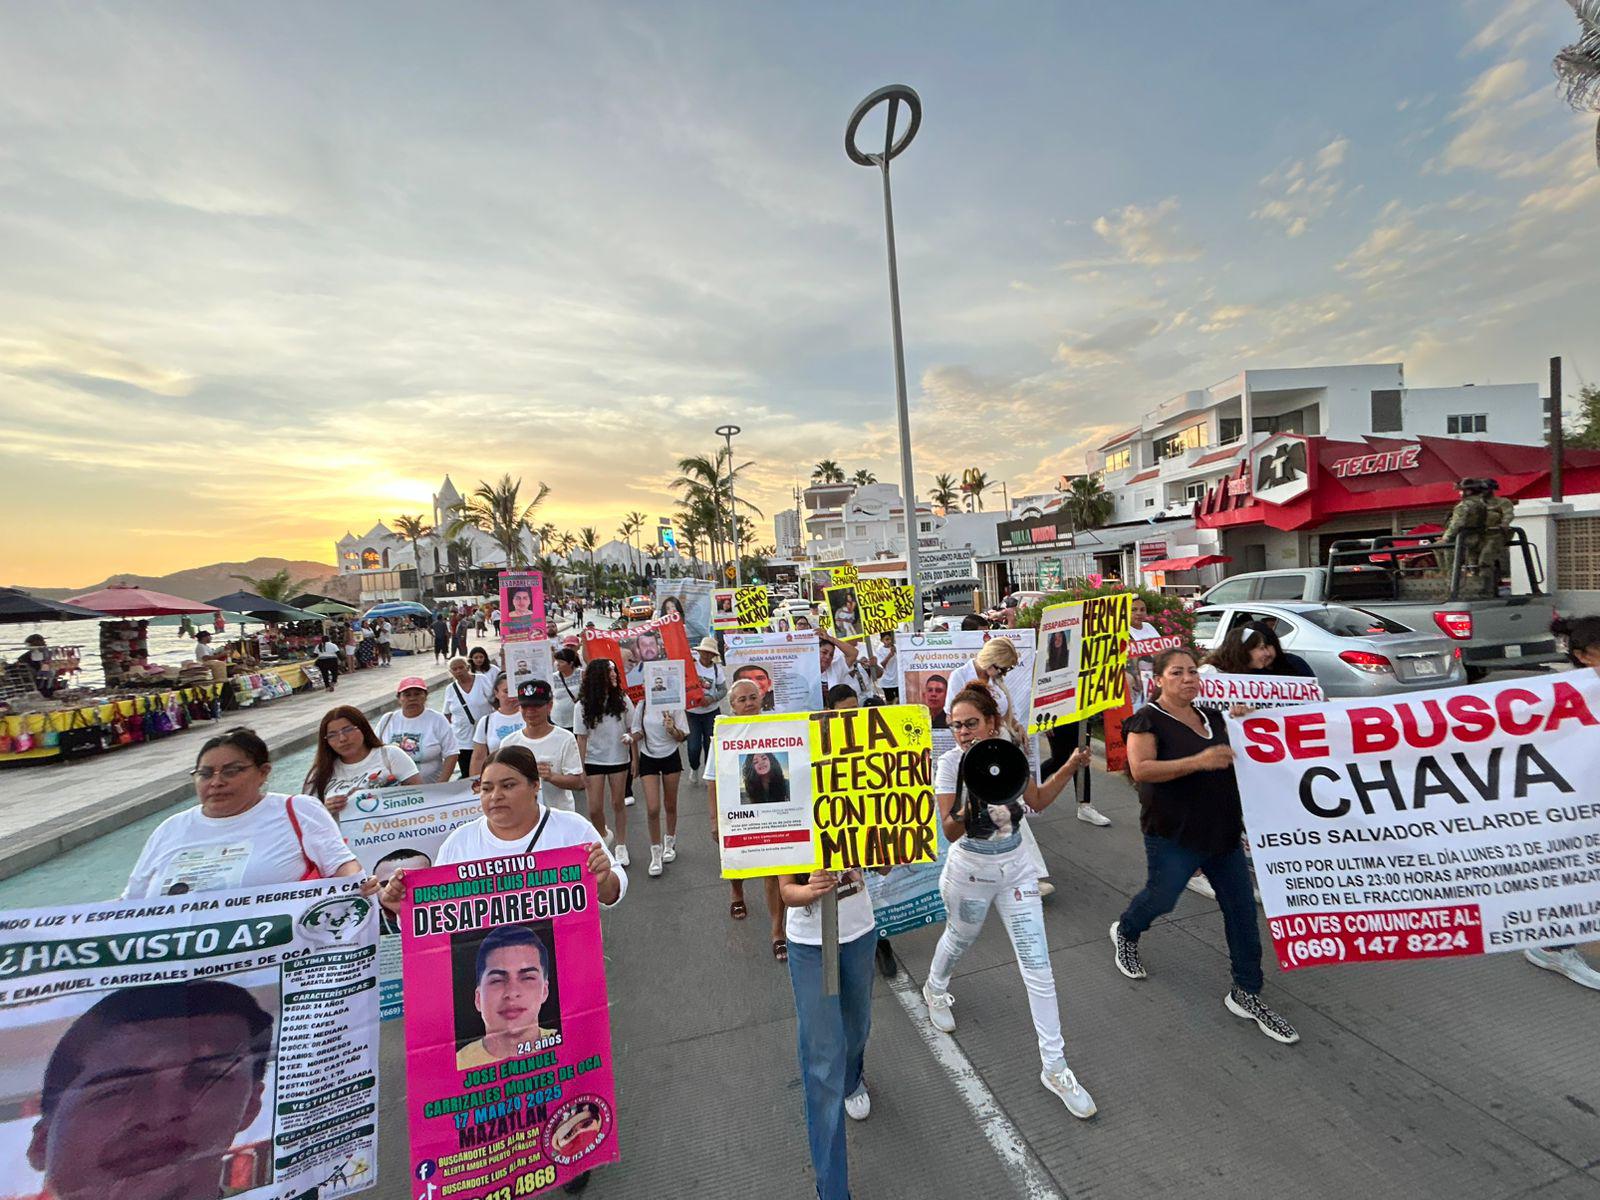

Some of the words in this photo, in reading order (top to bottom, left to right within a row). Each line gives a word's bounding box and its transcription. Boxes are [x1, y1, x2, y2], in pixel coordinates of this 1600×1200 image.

[1331, 445, 1421, 478] TECATE
[585, 611, 680, 641] DESAPARECIDO
[862, 604, 886, 620] TUS
[1042, 617, 1080, 632] DESAPARECIDA
[1082, 596, 1128, 637] HERMA
[1081, 634, 1119, 670] NITA
[1228, 680, 1239, 698] A
[1239, 680, 1321, 701] LOCALIZAR
[809, 706, 899, 755] TIA
[1242, 712, 1330, 763] SE
[1346, 682, 1599, 754] BUSCA
[722, 736, 804, 751] DESAPARECIDA
[1300, 743, 1576, 818] CHAVA
[382, 795, 425, 810] Sinaloa
[440, 810, 448, 819] a
[727, 810, 755, 820] CHINA
[354, 832, 395, 846] MARCO
[399, 824, 447, 839] ANTONIO
[1257, 828, 1321, 848] JESÚS
[1327, 822, 1438, 844] SALVADOR
[1440, 810, 1543, 834] VELARDE
[457, 855, 537, 879] COLECTIVO
[1266, 860, 1302, 875] VISTO
[1305, 859, 1334, 872] POR
[1337, 856, 1385, 870] ULTIMA
[1387, 855, 1415, 868] VEZ
[1419, 854, 1435, 867] EL
[1462, 845, 1504, 862] LUNES
[1504, 843, 1522, 858] 23
[1524, 841, 1542, 855] DE
[1546, 836, 1583, 853] JUNIO
[413, 878, 494, 904] BUSCANDOTE
[497, 874, 524, 892] LUIS
[526, 869, 559, 887] ALAN
[560, 865, 582, 883] SM
[1285, 876, 1334, 890] SIENDO
[1338, 875, 1364, 887] LAS
[1367, 873, 1400, 886] 23:00
[1404, 870, 1451, 884] HORAS
[1286, 894, 1319, 907] MIRO
[1322, 893, 1344, 905] EN
[1345, 892, 1361, 904] EL
[1364, 884, 1492, 903] FRACCIONAMIENTO
[1495, 877, 1539, 894] LOMAS
[1542, 874, 1560, 888] DE
[34, 914, 66, 928] LUZ
[71, 912, 83, 924] Y
[85, 905, 175, 923] ESPERANZA
[180, 901, 219, 913] PARA
[225, 896, 251, 908] QUE
[256, 887, 322, 904] REGRESEN
[327, 885, 337, 895] A
[413, 884, 588, 938] DESAPARECIDO
[1270, 921, 1285, 940] SI
[1286, 918, 1307, 938] LO
[1307, 916, 1341, 934] VES
[1344, 909, 1451, 933] COMUNICATE
[1453, 908, 1480, 927] AL:
[1489, 922, 1576, 945] ESTRAÑA
[0, 941, 100, 975] ¿HAS
[108, 928, 220, 962] VISTO
[227, 920, 273, 950] A?
[328, 954, 342, 963] VEZ
[1287, 937, 1346, 966] (669)
[1353, 935, 1400, 955] 147
[1407, 930, 1469, 952] 8224
[13, 978, 95, 1000] EMANUEL
[100, 970, 188, 986] CARRIZALES
[193, 959, 252, 976] MONTES
[258, 954, 277, 965] DE
[282, 948, 311, 961] OCA
[305, 966, 327, 974] MARZO
[291, 1004, 312, 1012] EDAD:
[324, 999, 345, 1008] AÑOS
[291, 1013, 312, 1021] CARA:
[314, 1007, 350, 1019] OVALADA
[311, 1035, 342, 1048] GRANDE
[313, 1025, 349, 1038] MEDIANA
[518, 1043, 532, 1055] 24
[535, 1034, 563, 1051] años
[307, 1054, 340, 1068] MORENA
[342, 1044, 369, 1056] CLARA
[317, 1041, 352, 1056] GRUESOS
[324, 1054, 361, 1072] CASTAÑO
[337, 1069, 373, 1085] DELGADA
[464, 1067, 497, 1088] JOSE
[501, 1051, 558, 1079] EMANUEL
[424, 1086, 501, 1118] CARRIZALES
[505, 1072, 555, 1096] MONTES
[558, 1064, 574, 1081] DE
[578, 1055, 602, 1074] OCA
[453, 1112, 469, 1129] 17
[474, 1096, 522, 1125] MARZO
[526, 1084, 562, 1108] 2025
[459, 1104, 548, 1149] MAZATLAN
[438, 1146, 487, 1168] BUSCANDOTE
[489, 1140, 506, 1153] LUIS
[507, 1131, 525, 1146] ALAN
[527, 1127, 540, 1139] SM
[442, 1175, 490, 1196] BUSCANDOTE
[491, 1167, 508, 1182] LUIS
[509, 1157, 527, 1174] ALAN
[528, 1152, 541, 1164] SM
[443, 1164, 466, 1177] ALERTA
[466, 1159, 488, 1171] AMBER
[489, 1150, 511, 1164] PUERTO
[515, 1164, 556, 1196] 4868
